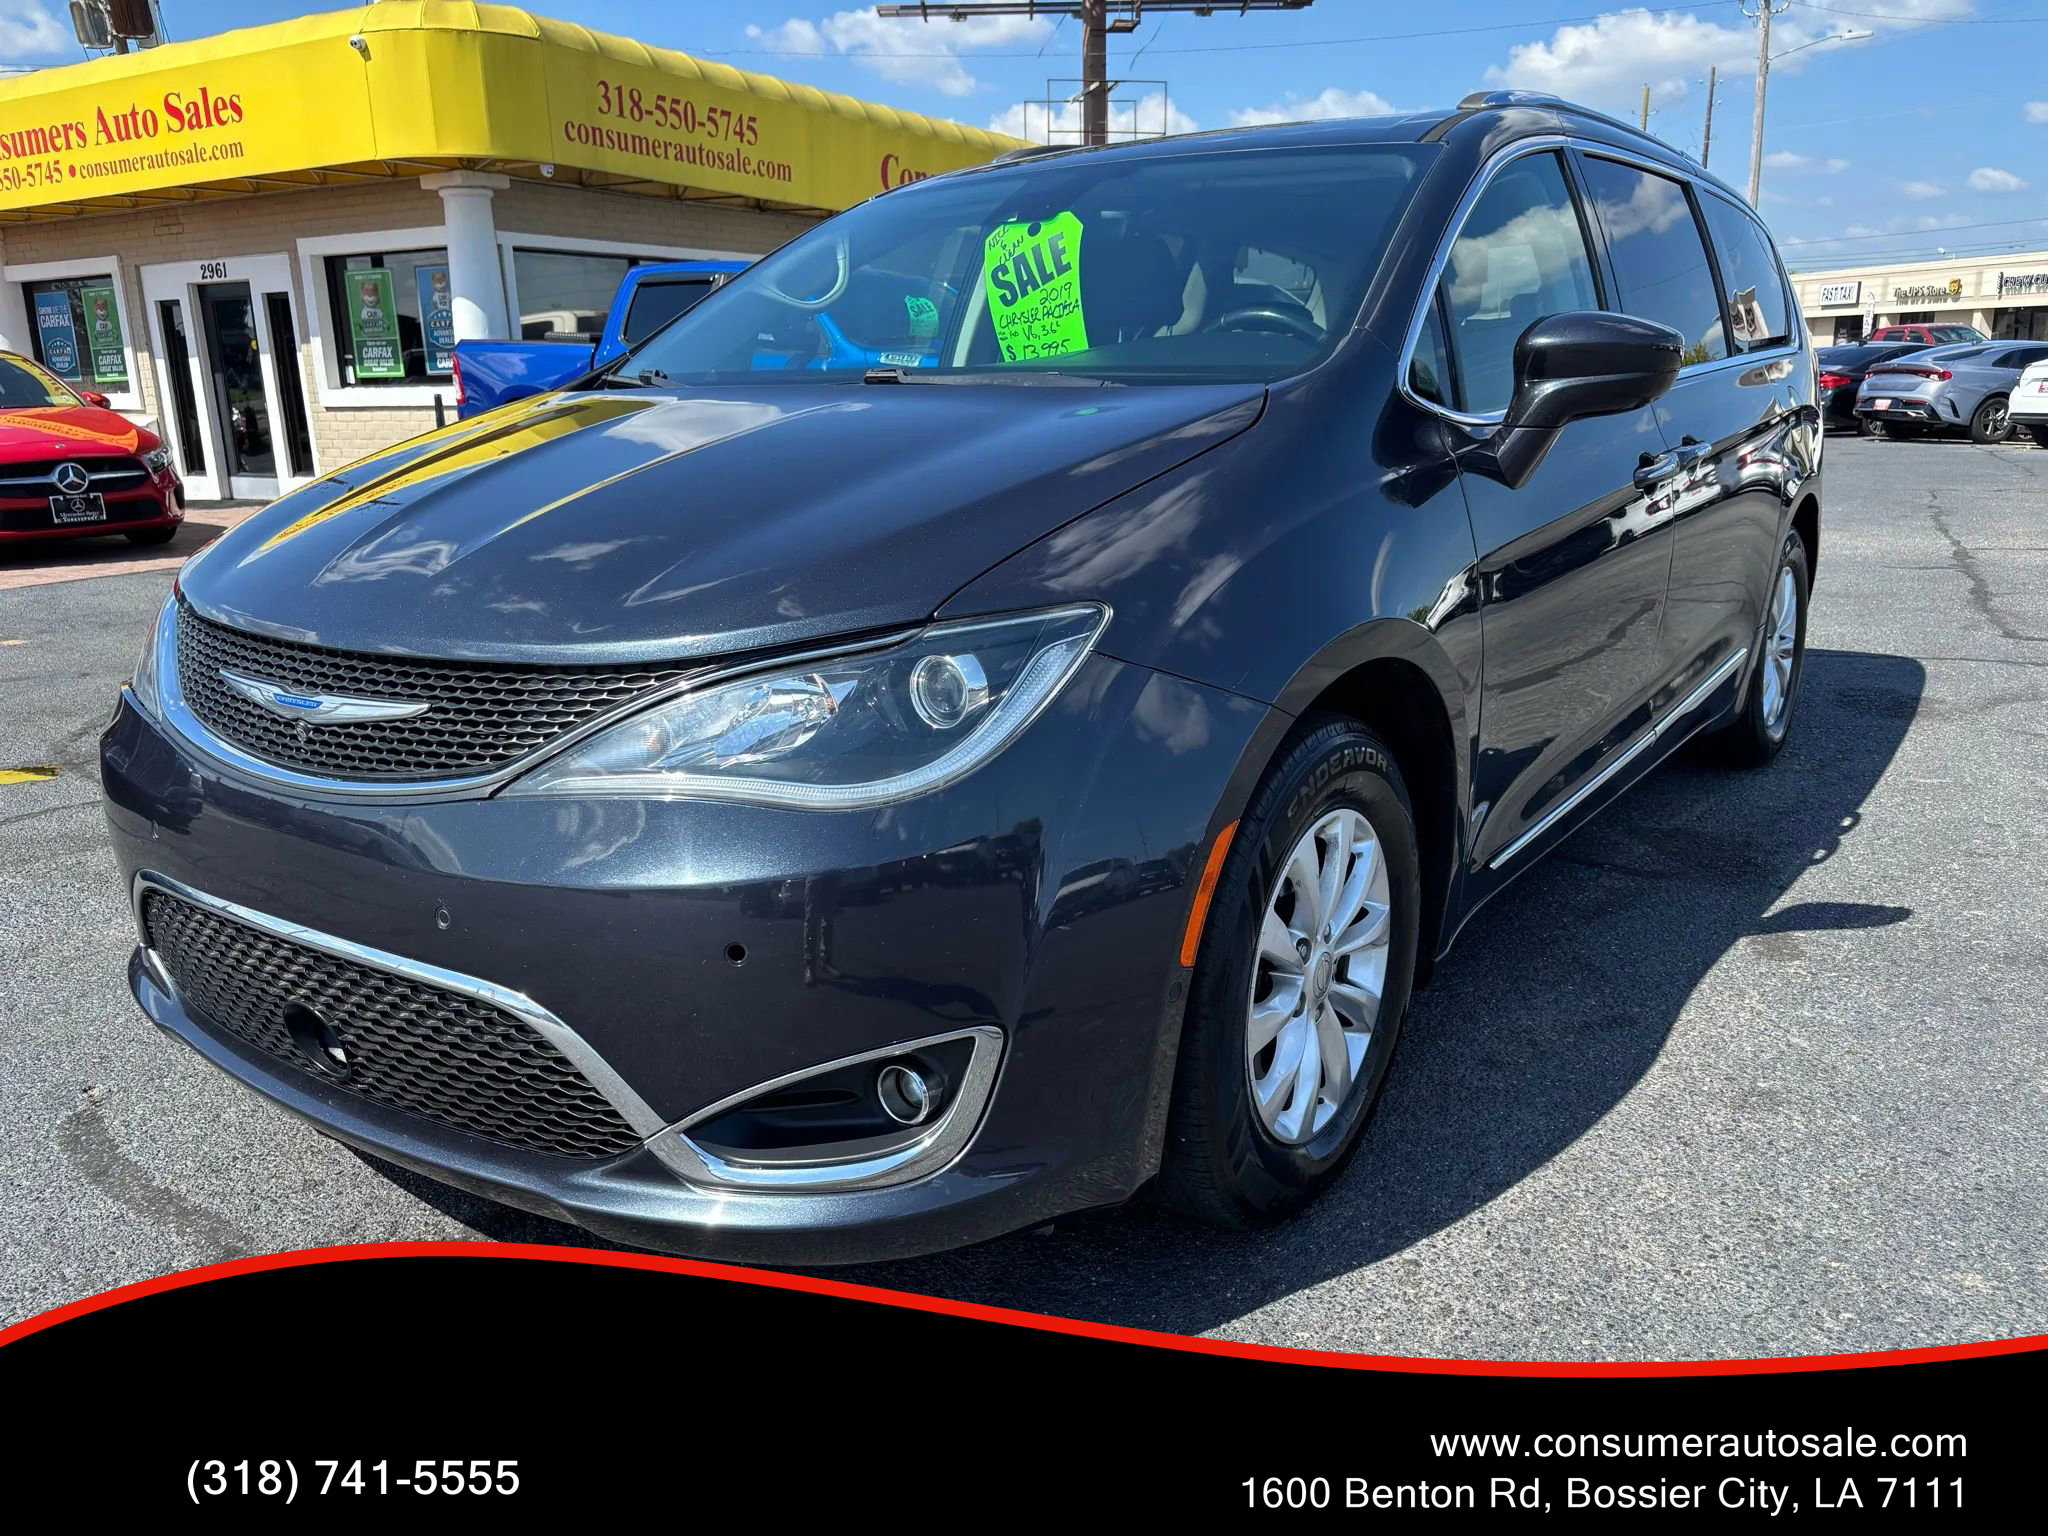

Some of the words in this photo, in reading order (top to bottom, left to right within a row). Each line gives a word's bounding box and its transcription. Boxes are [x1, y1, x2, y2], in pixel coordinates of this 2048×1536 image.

[0, 120, 87, 160] sumers
[95, 102, 158, 145] Auto
[163, 86, 243, 133] Sales
[597, 80, 758, 145] 318-550-5745
[80, 141, 244, 179] consumerautosale.com
[564, 120, 792, 182] consumerautosale.com
[988, 225, 1009, 251] NICE
[200, 261, 227, 280] 2961
[991, 232, 1072, 307] SALE
[1040, 282, 1072, 305] 2019
[1893, 287, 1907, 297] The
[1907, 286, 1925, 297] UPS
[1925, 285, 1947, 296] Store
[40, 314, 70, 328] CARFAX
[1000, 307, 1041, 330] CHRYSLER
[98, 354, 122, 365] CARFAX
[362, 346, 392, 358] CARFAX
[1287, 746, 1389, 820] ENDEAVOR
